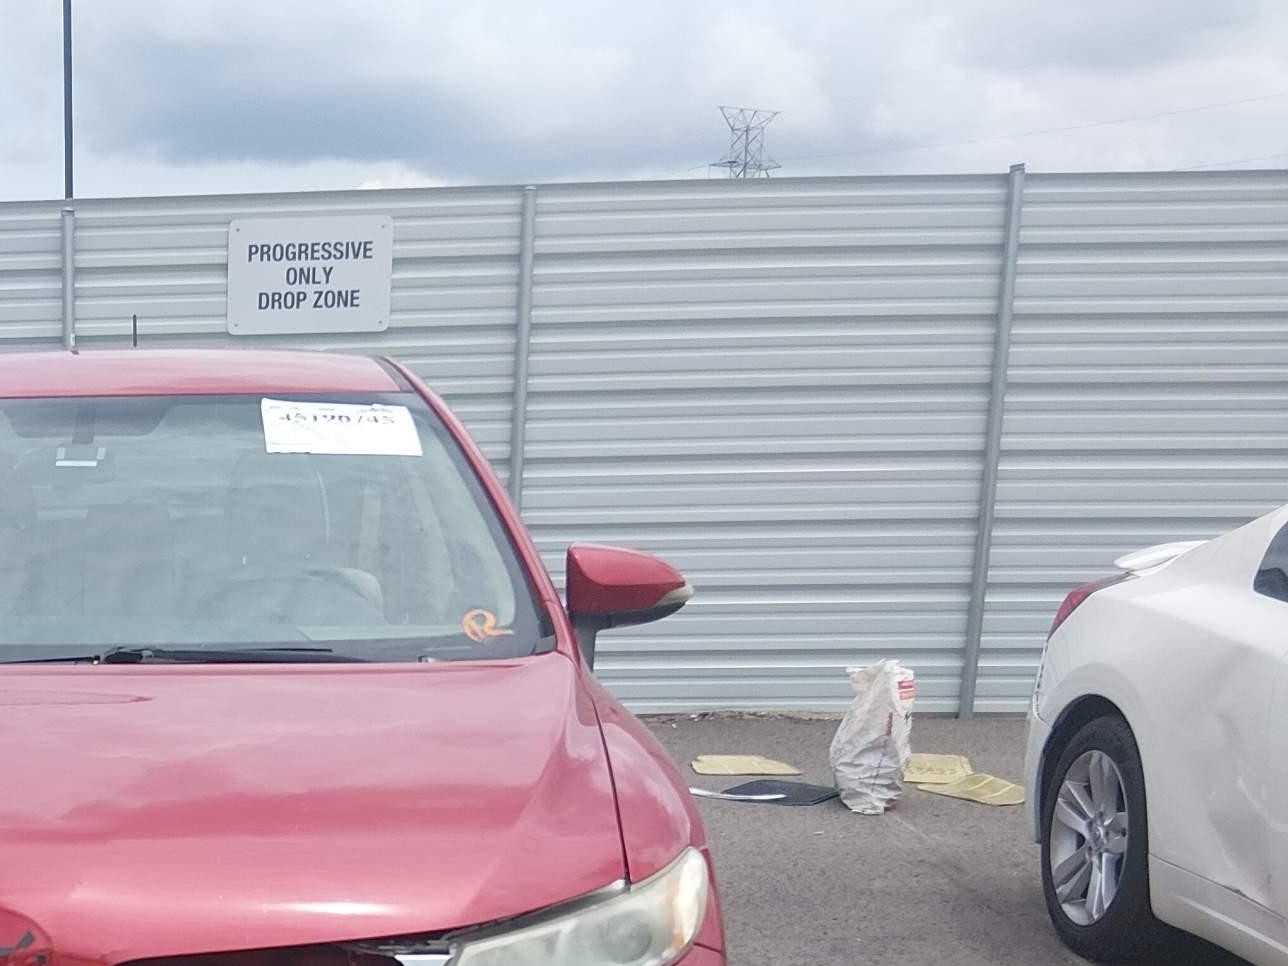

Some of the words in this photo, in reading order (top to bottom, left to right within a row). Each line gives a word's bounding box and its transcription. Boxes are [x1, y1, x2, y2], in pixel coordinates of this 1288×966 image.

[248, 241, 373, 262] PROGRESSIVE
[286, 266, 333, 285] ONLY
[258, 292, 307, 310] DROP
[312, 290, 360, 308] ZONE
